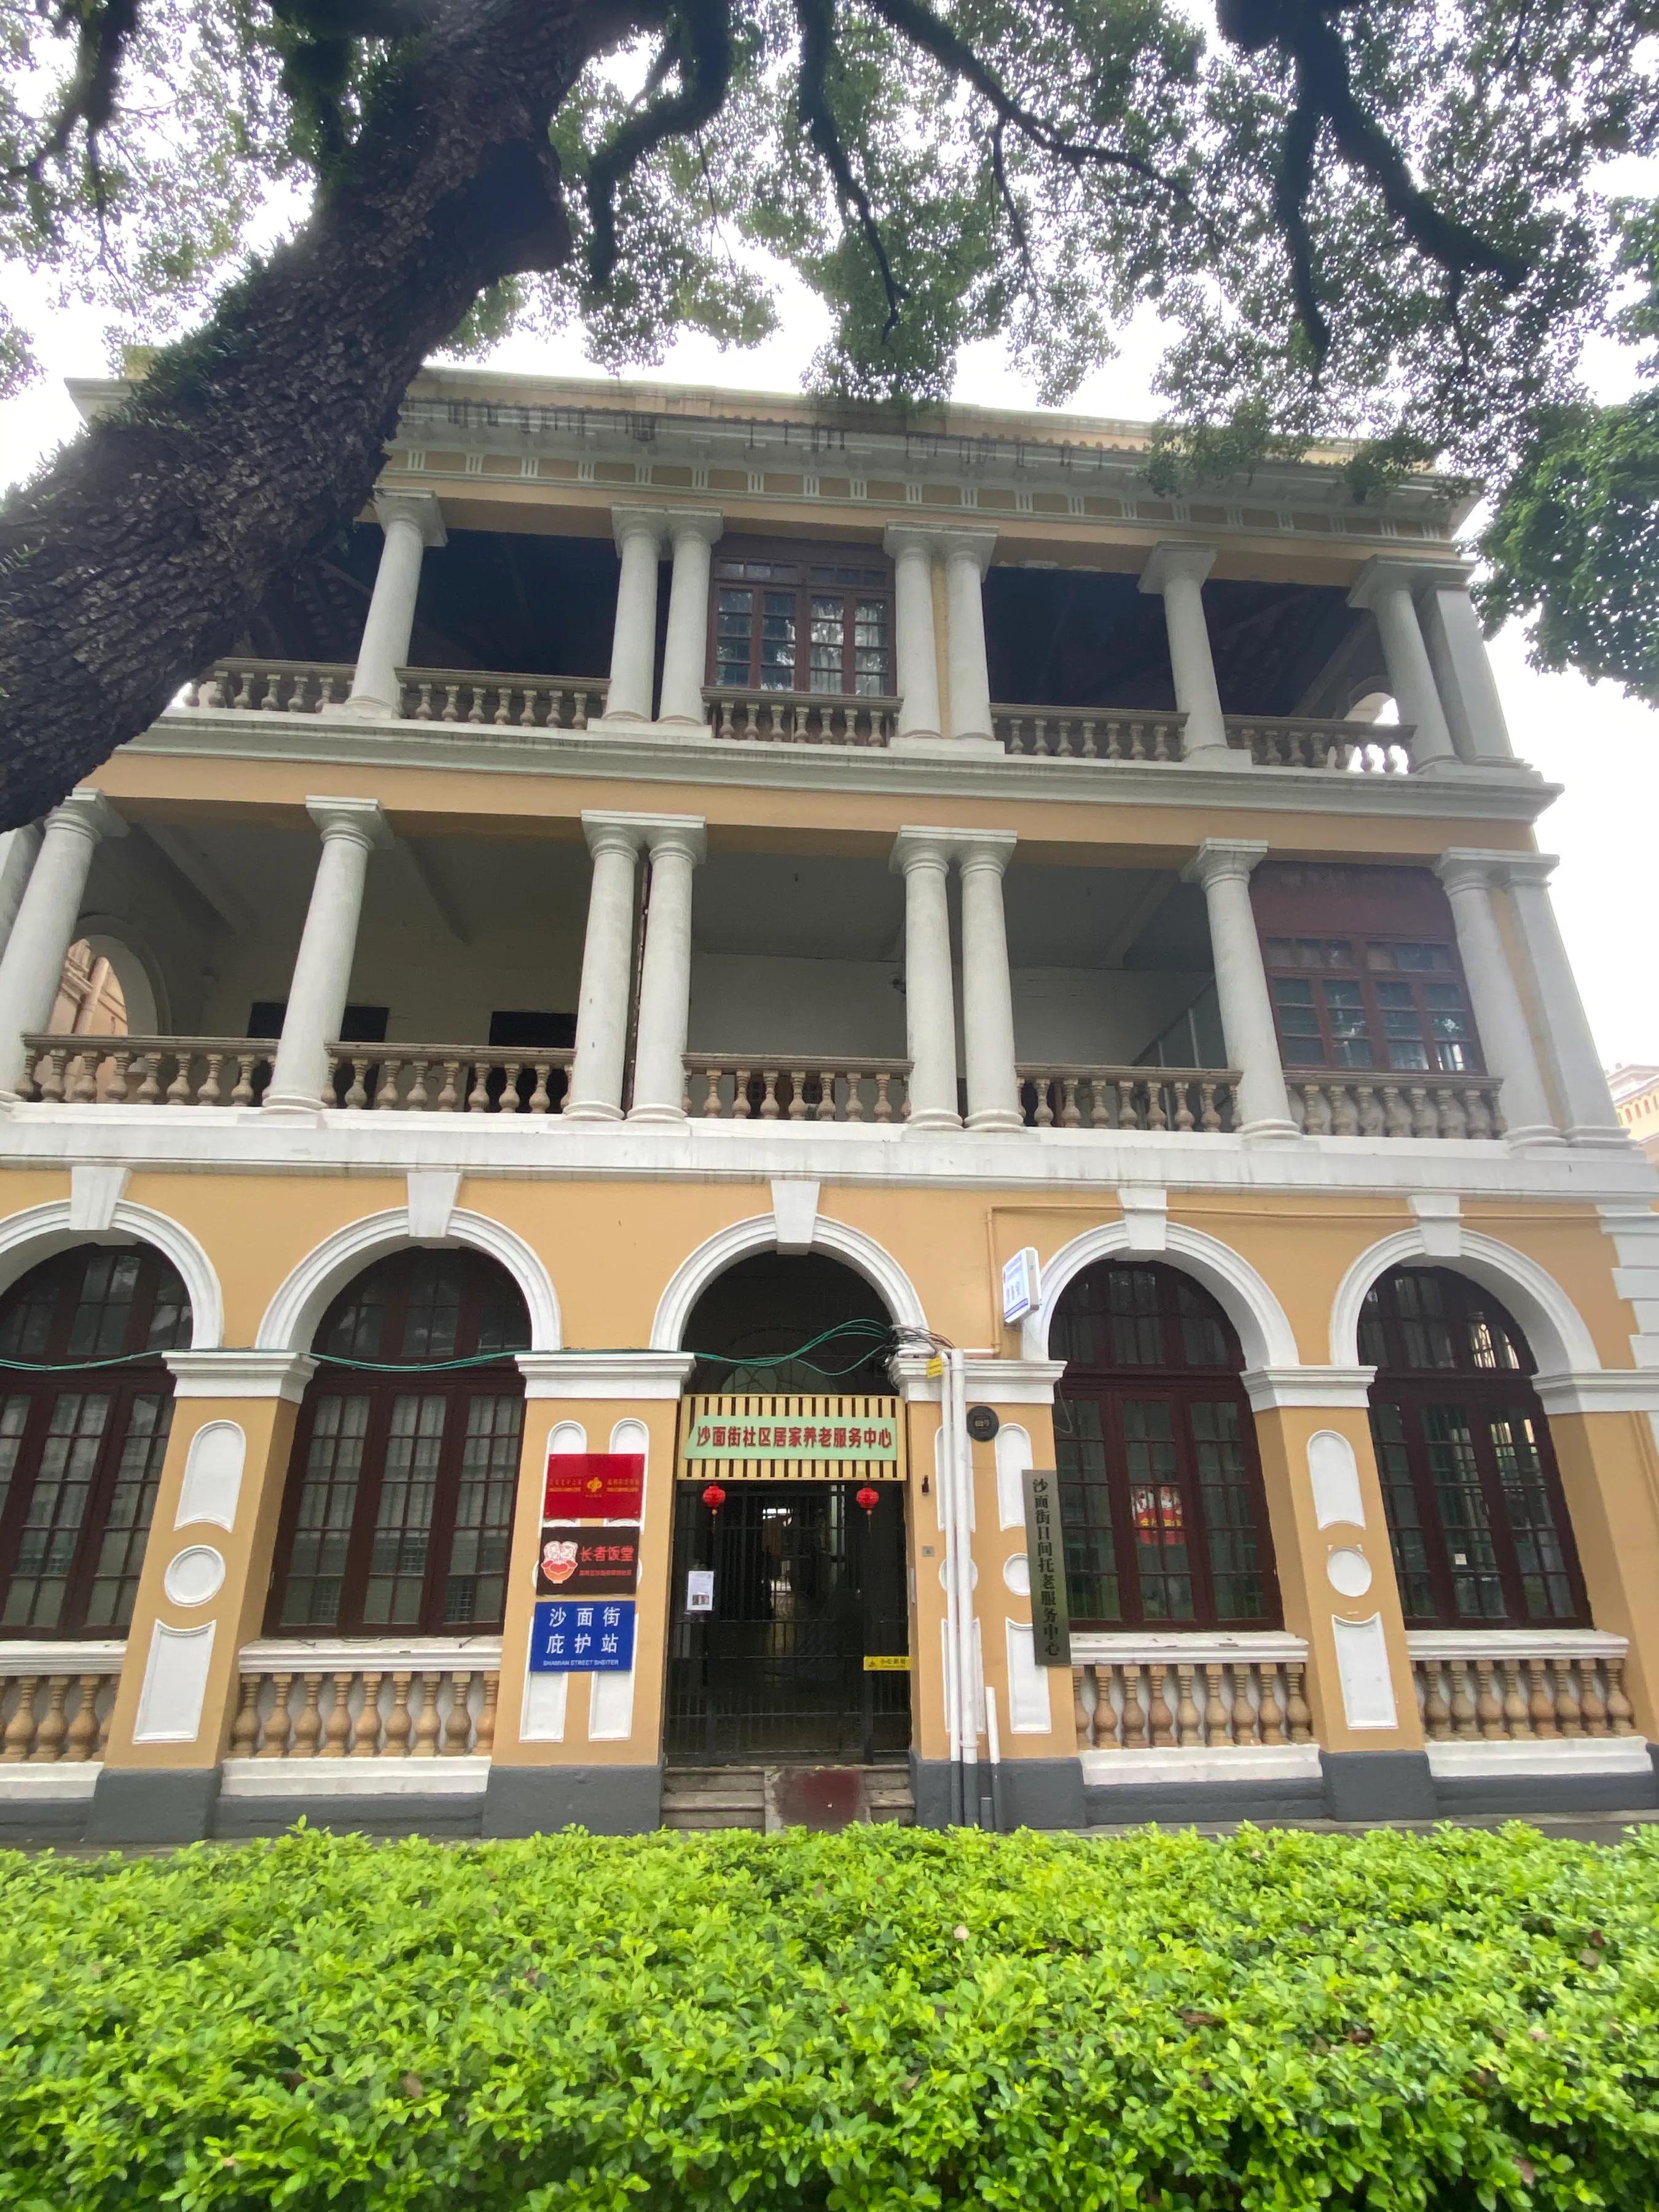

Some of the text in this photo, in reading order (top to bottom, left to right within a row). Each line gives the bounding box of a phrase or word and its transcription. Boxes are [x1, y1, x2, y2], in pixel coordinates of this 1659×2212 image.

[696, 1426, 892, 1449] 沙面街社区居家养老服务中心
[580, 1545, 635, 1562] 长者饭堂
[1032, 1478, 1061, 1656] 沙面街日间托老服务中心
[549, 1606, 621, 1627] 沙面街
[546, 1633, 619, 1654] 庇护站
